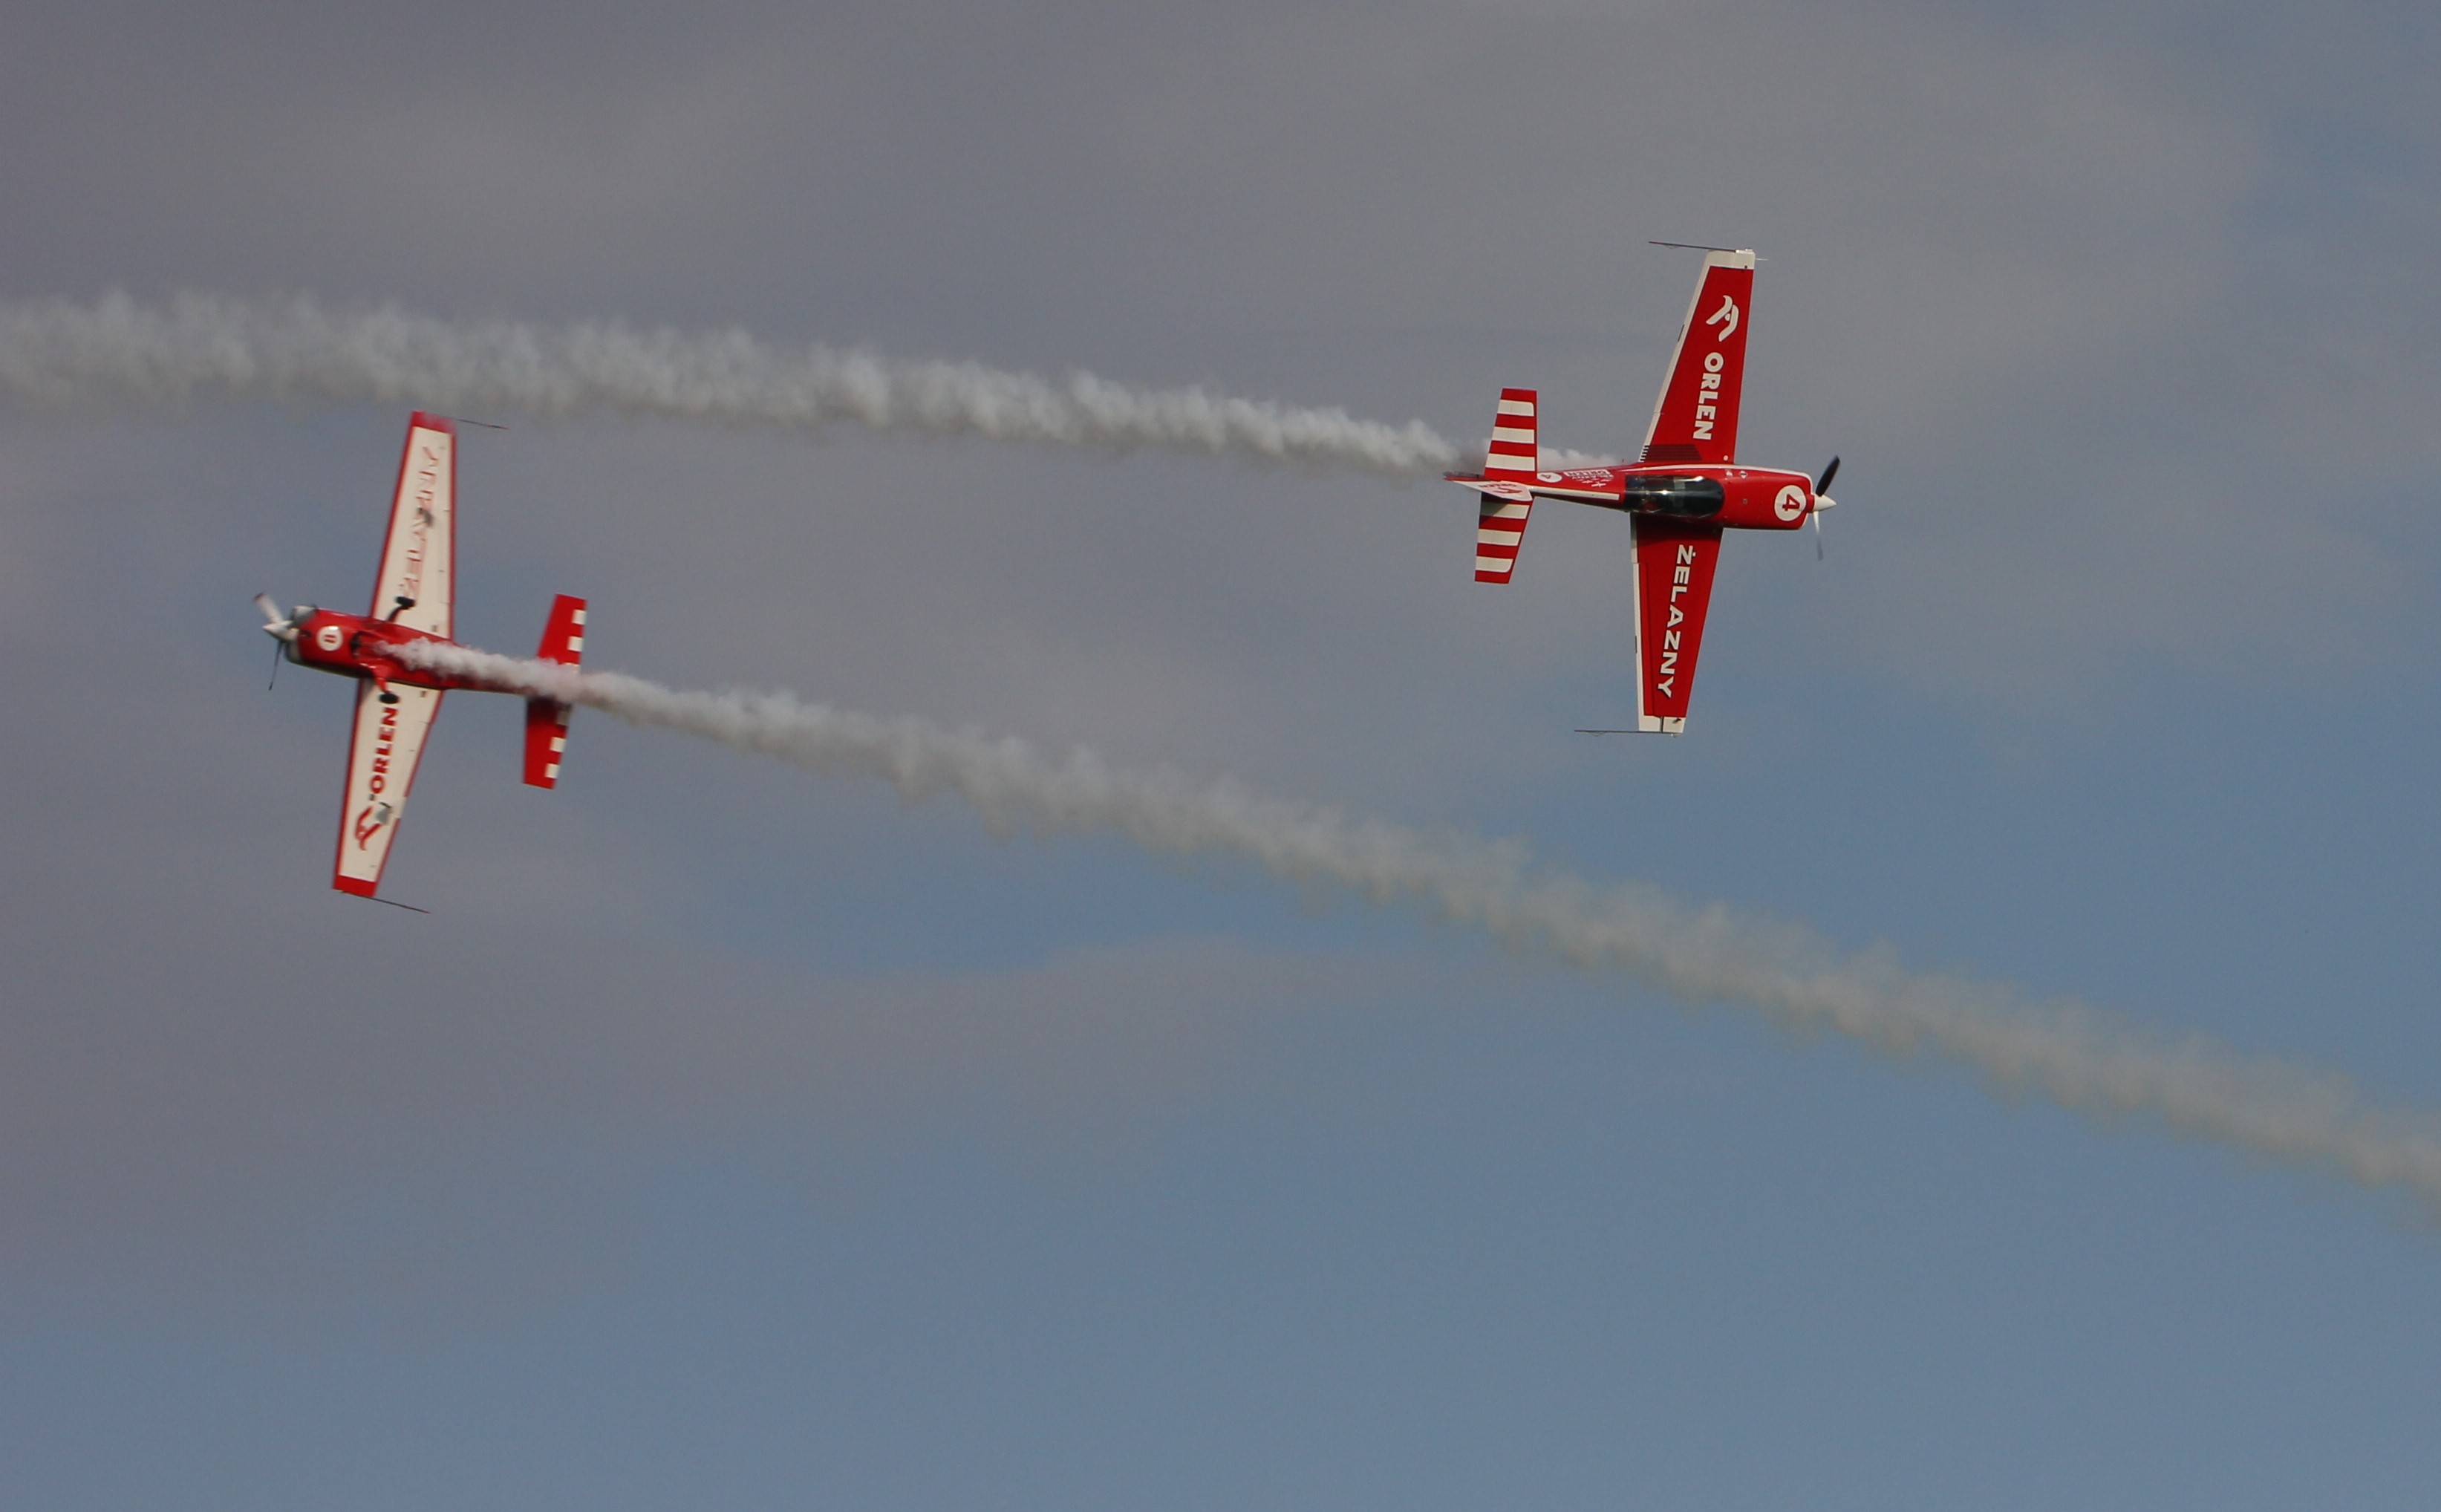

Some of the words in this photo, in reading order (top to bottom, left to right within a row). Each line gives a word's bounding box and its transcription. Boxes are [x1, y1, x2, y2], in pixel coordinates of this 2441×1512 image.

[1692, 352, 1724, 440] ORLEN
[1782, 493, 1801, 512] 4
[1658, 544, 1696, 698] ŻELAZNY
[370, 707, 399, 794] ORLEN
